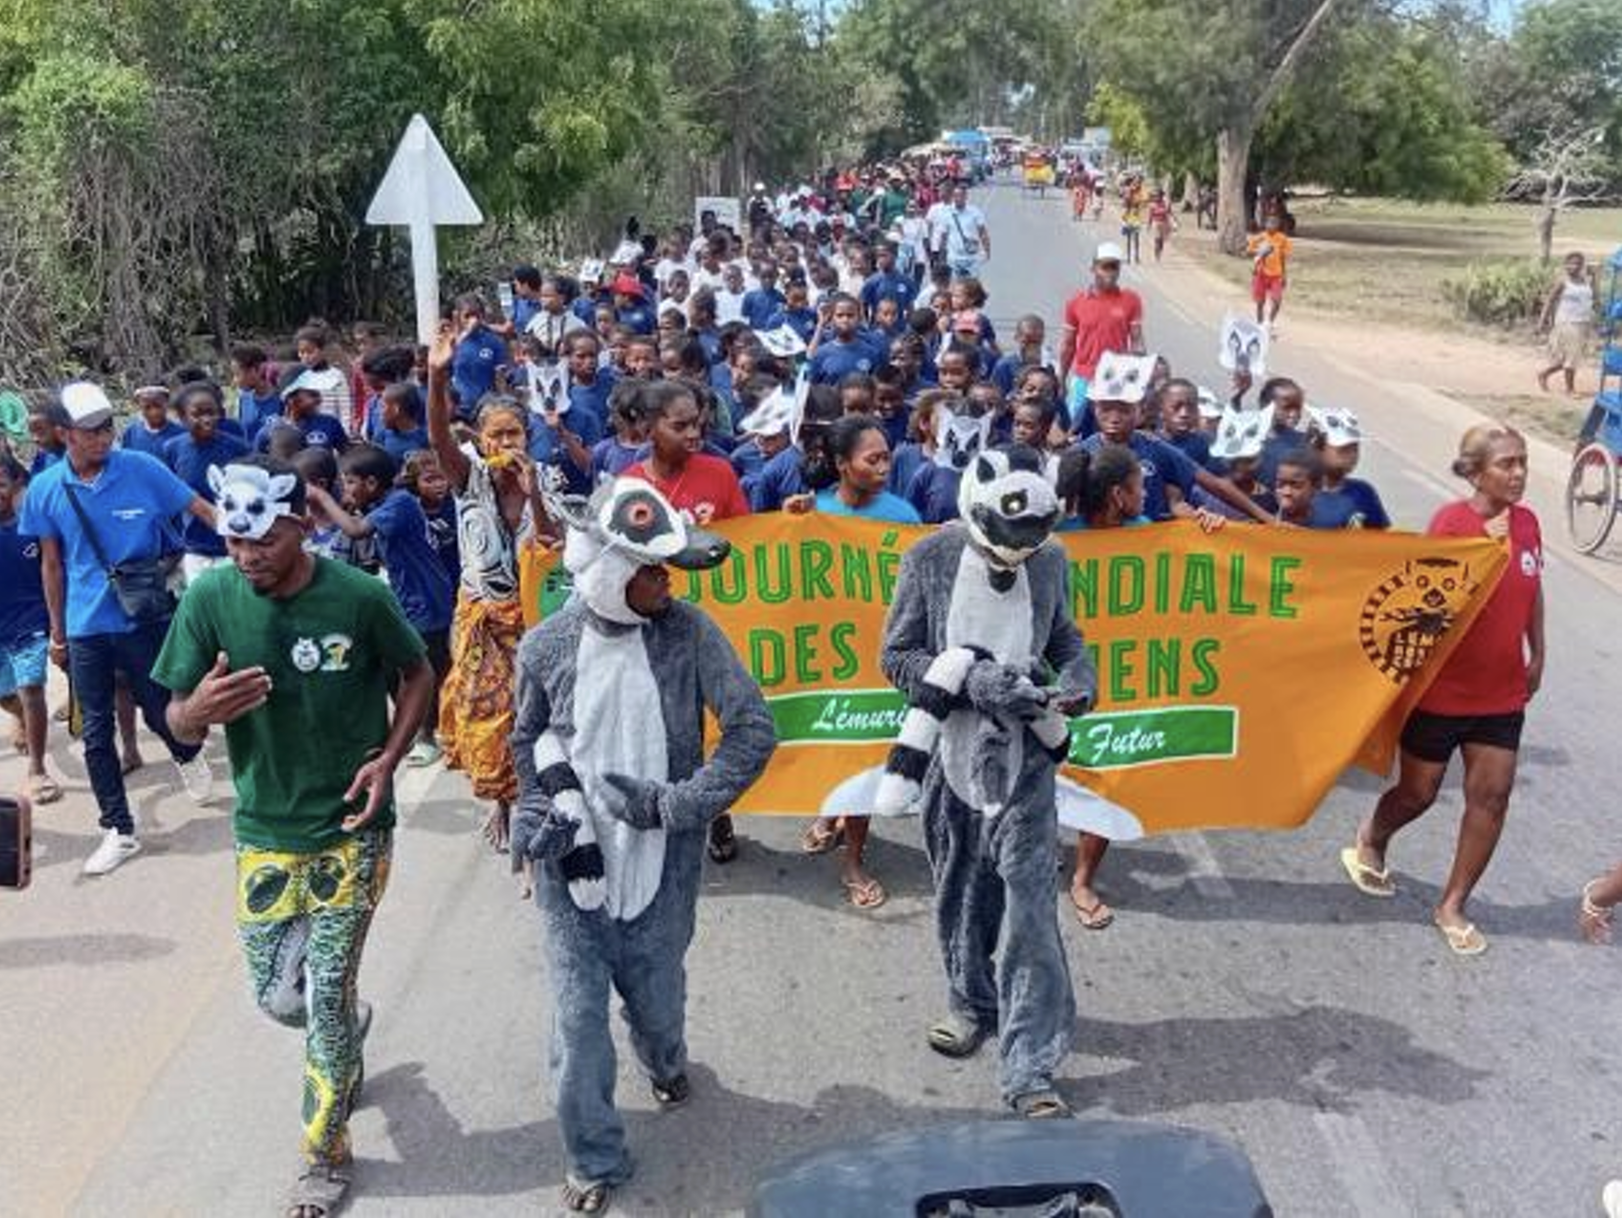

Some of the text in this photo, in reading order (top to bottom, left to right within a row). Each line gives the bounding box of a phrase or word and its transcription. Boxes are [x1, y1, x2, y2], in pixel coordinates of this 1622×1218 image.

[1071, 552, 1302, 618] NDIALE
[749, 621, 859, 687] DES
[1087, 723, 1166, 764] Futur
